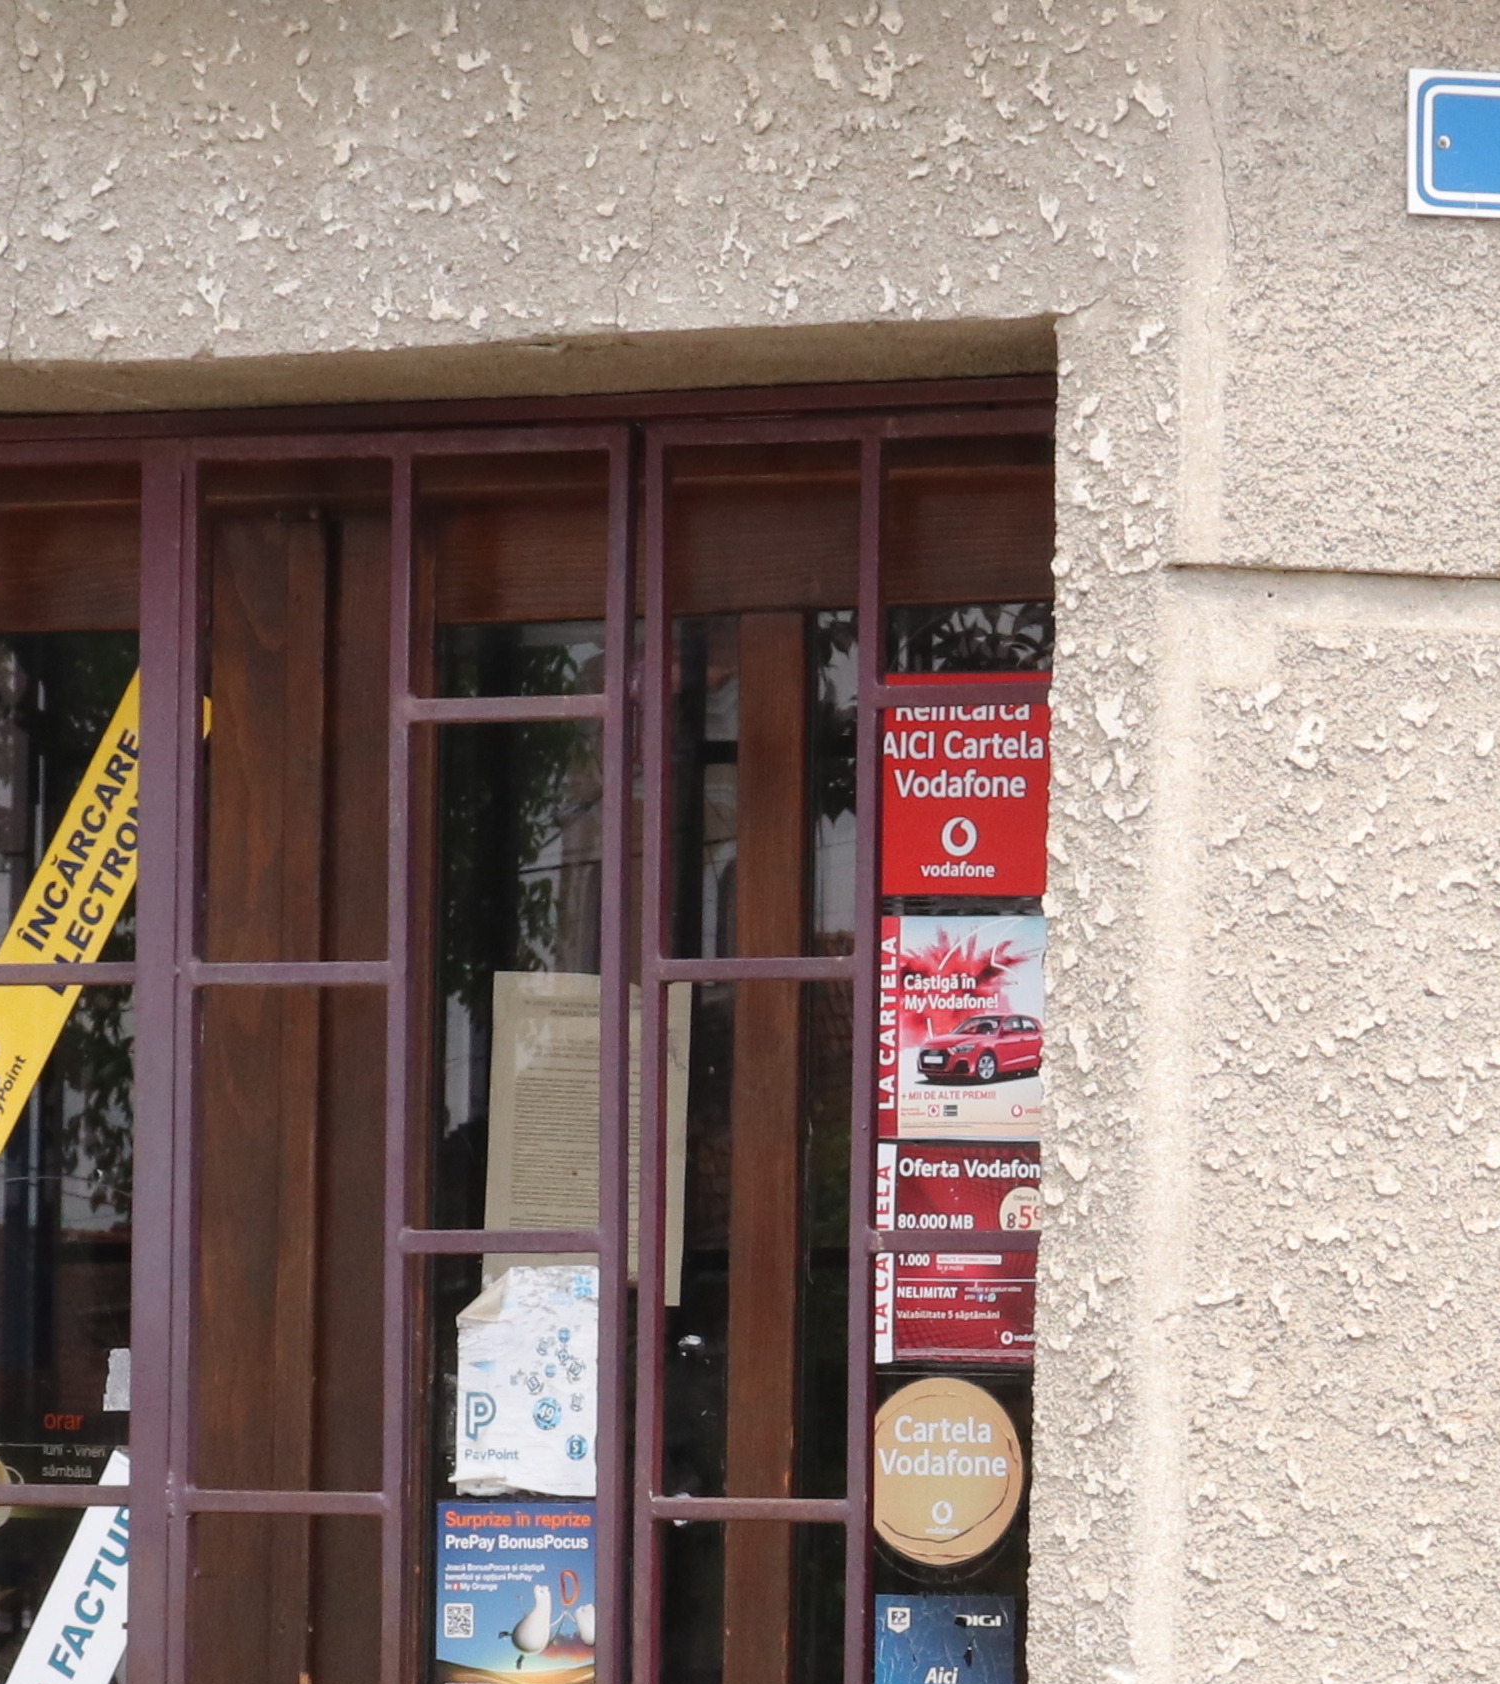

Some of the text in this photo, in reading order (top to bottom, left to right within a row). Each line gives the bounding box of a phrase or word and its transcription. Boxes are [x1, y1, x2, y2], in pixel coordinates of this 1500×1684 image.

[883, 730, 1044, 759] AICI Cartela
[894, 768, 1027, 798] Vodafone
[17, 729, 140, 952] ÎNCĂRCARE
[920, 861, 996, 878] vodafone
[961, 973, 976, 990] în
[904, 994, 999, 1013] My Vodafone!
[879, 936, 897, 1109] LA CARTELA
[899, 1157, 1041, 1179] Oferta Vodafon
[897, 1214, 974, 1230] 80.000 MB
[898, 1253, 930, 1267] 1.000
[896, 1286, 958, 1298] NELIMITAT
[875, 1303, 889, 1334] LA
[896, 1309, 947, 1320] Valabilitate
[947, 1310, 954, 1319] 5
[43, 1412, 84, 1430] orar
[894, 1415, 993, 1443] Cartela
[878, 1448, 1008, 1477] Vodafone
[444, 1510, 513, 1530] Surprize
[534, 1511, 592, 1531] reprize
[445, 1534, 589, 1552] PrePay BonusPocus
[924, 1667, 959, 1684] Aici
